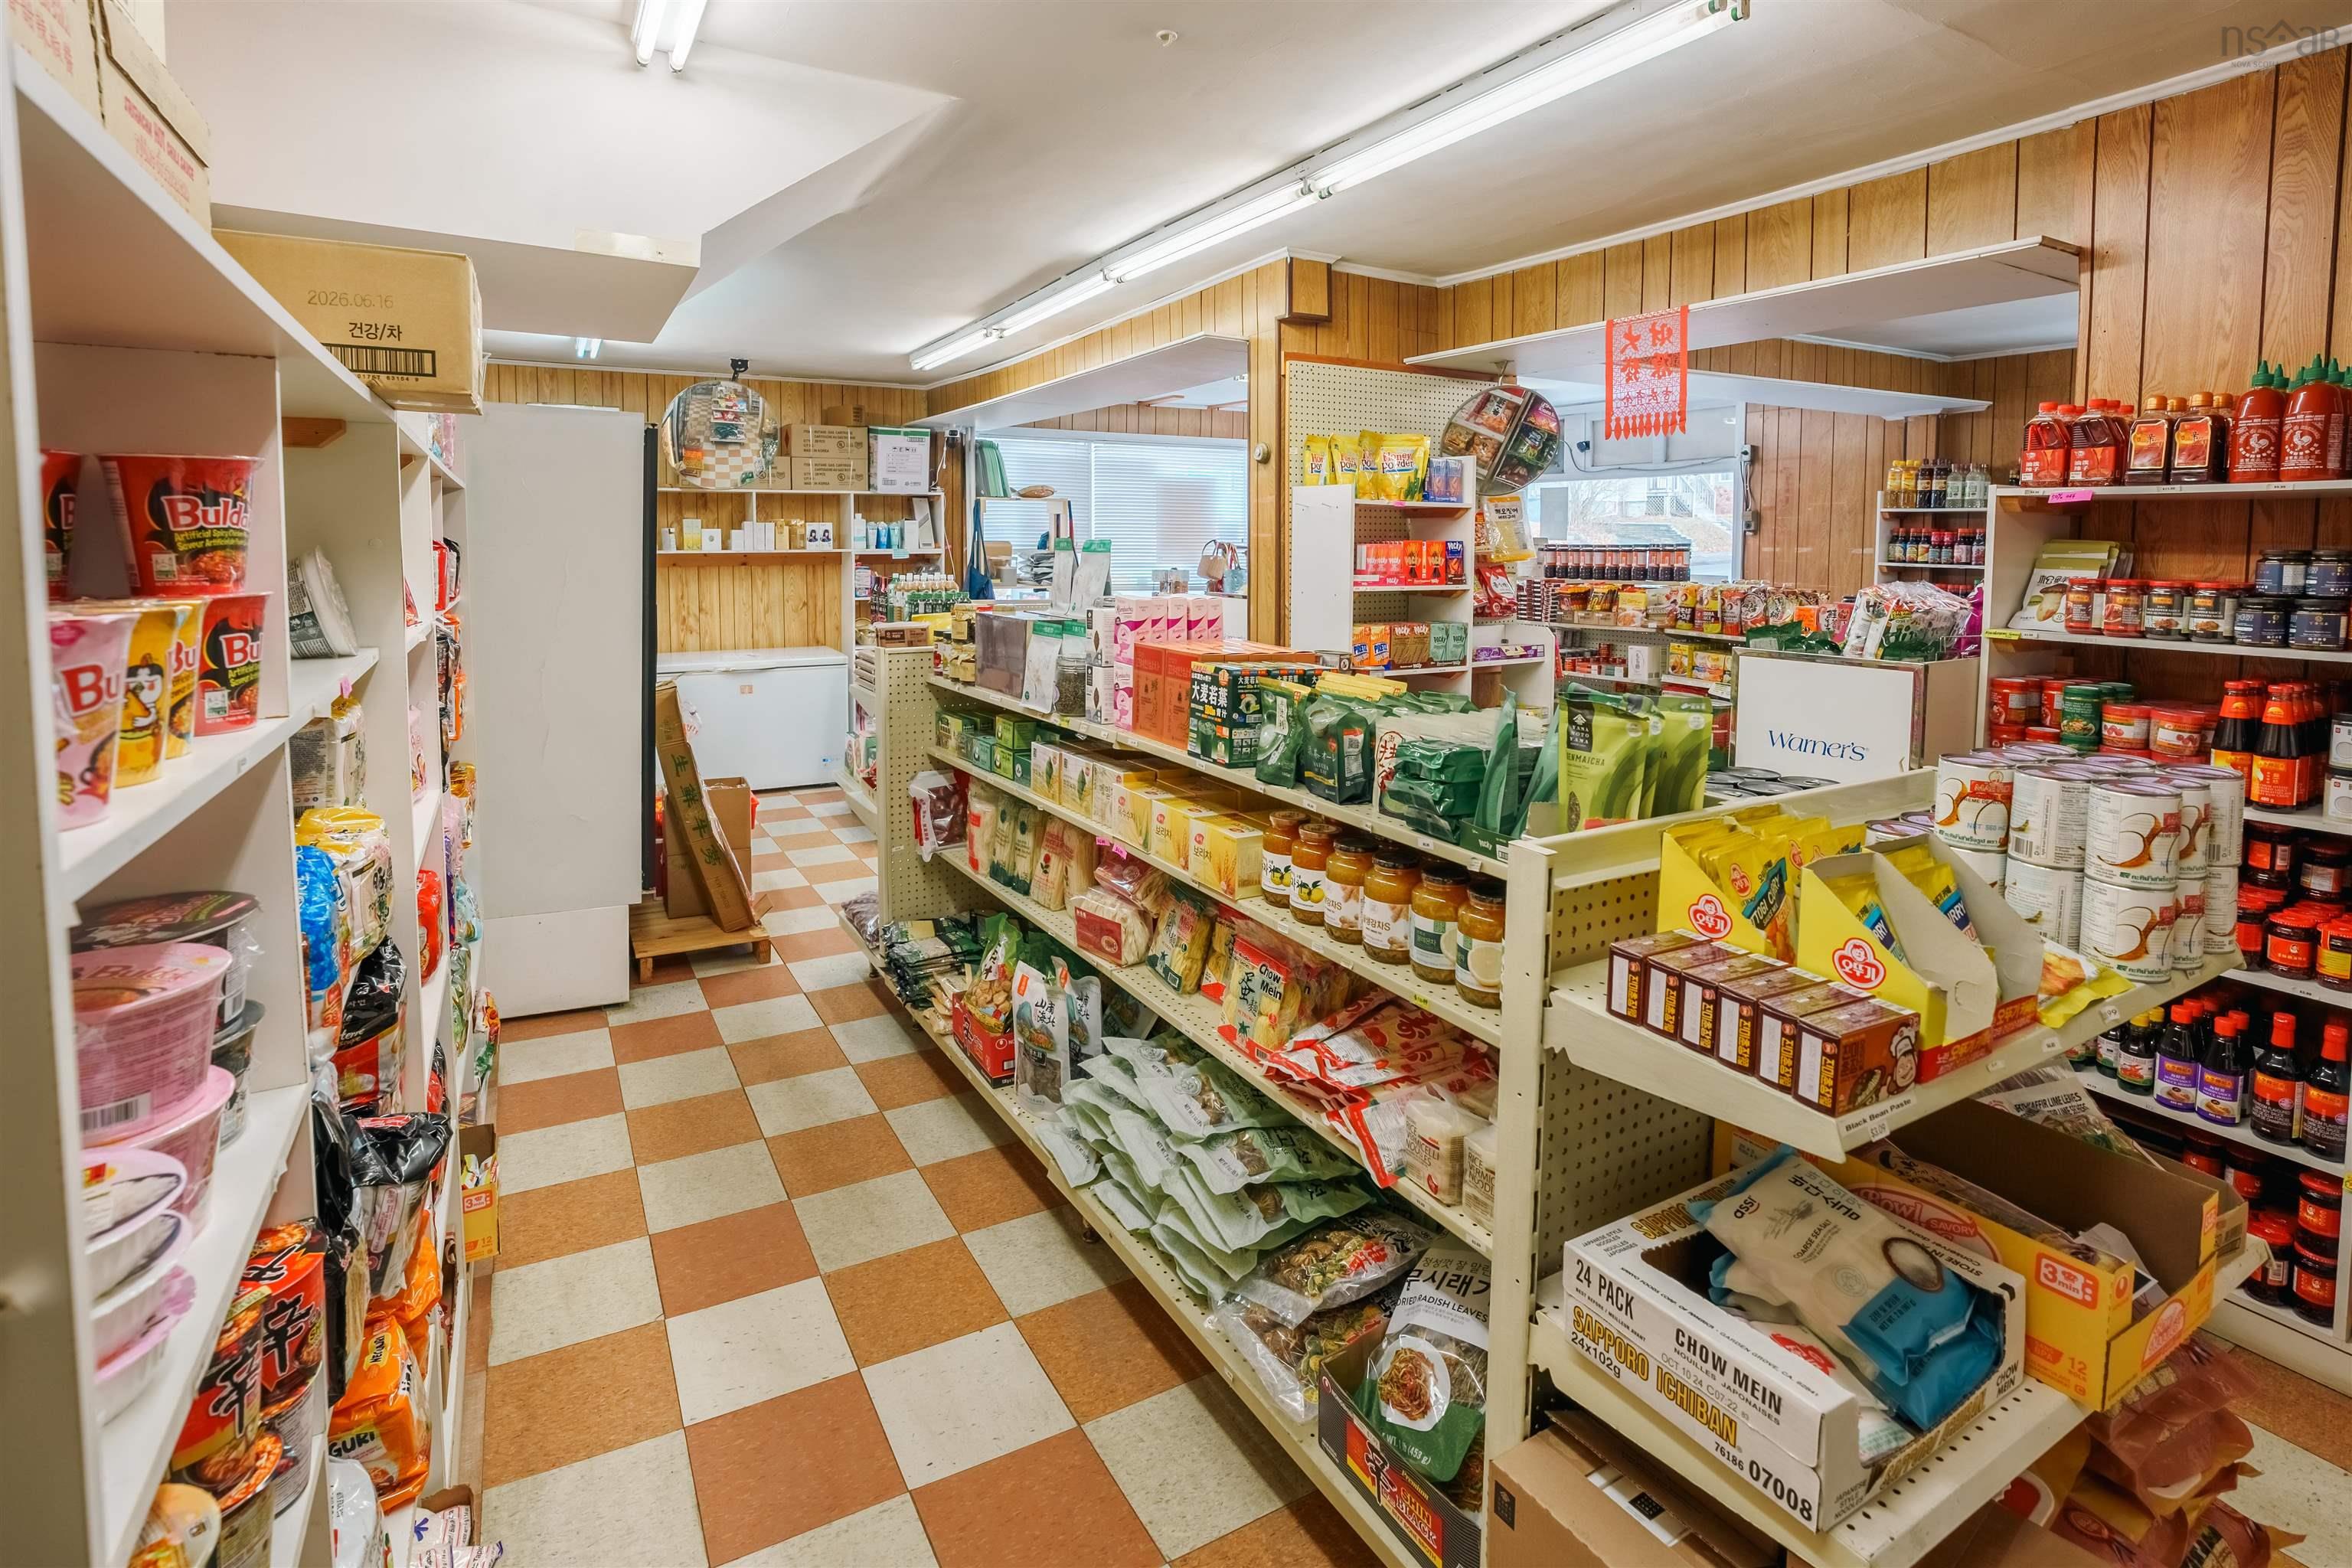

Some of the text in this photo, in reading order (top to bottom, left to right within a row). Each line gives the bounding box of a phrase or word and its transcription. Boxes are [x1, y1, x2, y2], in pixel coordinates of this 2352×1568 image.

[308, 290, 394, 309] 2026.06.16
[348, 322, 403, 341] 건강/차
[1381, 461, 1415, 474] Powder
[1447, 541, 1462, 551] POCKY
[1394, 626, 1410, 635] POCKY
[1413, 625, 1429, 635] POCKY
[1374, 642, 1388, 654] PRETZ
[1191, 681, 1228, 708] 大麦若葉
[1769, 730, 1866, 762] Warner's
[1155, 825, 1172, 841] 보리차
[1194, 845, 1212, 861] 보리차
[1768, 874, 1781, 904] CURRY
[1696, 913, 1724, 932] 오뚜기
[1259, 964, 1282, 985] Chow
[1841, 959, 1876, 981] 오뚜기
[1260, 979, 1282, 1001] Mein
[2047, 1095, 2062, 1107] LIME
[1845, 1097, 1913, 1133] Black Bean Paste
[1406, 1120, 1417, 1135] RICE
[1870, 1123, 1886, 1138] $3.09
[1406, 1131, 1440, 1161] VERMICELLI
[1468, 1152, 1484, 1170] RICE
[464, 1198, 473, 1210] 3
[1733, 1194, 1759, 1219] assi
[1788, 1173, 1861, 1221] 바다소금
[1583, 1227, 1623, 1248] JAPANESE STYLE
[1929, 1218, 1976, 1236] SAVORY
[481, 1235, 492, 1245] 12
[1596, 1235, 1621, 1247] NOODLES
[1604, 1240, 1629, 1253] NOUILLES
[1608, 1243, 1638, 1258] JAPONAISES
[1793, 1236, 1814, 1259] COARSE
[1907, 1228, 1981, 1266] Conserver dans
[1422, 1256, 1454, 1269] 정성껏
[1456, 1260, 1468, 1272] 잘
[1931, 1249, 1983, 1277] STORE IN
[1576, 1259, 1635, 1320] 24 PACK
[2043, 1263, 2079, 1295] 3 min
[1396, 1294, 1488, 1323] DRIED RADISH LEAVES
[1576, 1288, 1586, 1296] BEST
[1587, 1294, 1604, 1311] BEFORE
[1608, 1311, 1630, 1331] MEILLEUR
[1631, 1328, 1646, 1342] AVANT
[1621, 1266, 1640, 1281] SANYO
[1640, 1279, 1661, 1294] FOODS
[1687, 1312, 1715, 1329] AMERICA
[1720, 1331, 1751, 1353] GARDEN
[1752, 1352, 1779, 1371] GROVE,
[1571, 1331, 1622, 1378] 24x102g
[1573, 1305, 1738, 1449] SAPPORO ICHIBAN
[1661, 1353, 1679, 1371] OCT
[1682, 1367, 1691, 1380] 10
[1692, 1376, 1704, 1388] 24
[1675, 1327, 1728, 1377] CHOW
[1733, 1367, 1783, 1416] MEIN
[1996, 1361, 2019, 1387] CHOW
[2068, 1357, 2088, 1376] 12
[1674, 1348, 1781, 1426] NOUILLES JAPONAISES
[1997, 1376, 2017, 1398] MEIN
[328, 1430, 375, 1458] GURI
[1406, 1446, 1423, 1462] (453
[1421, 1454, 1432, 1465] g)
[1402, 1469, 1429, 1501] Premium
[1714, 1441, 1813, 1523] 76186 07008
[1835, 1478, 1867, 1504] JAPANESE
[1400, 1485, 1432, 1529] SHIN
[1839, 1493, 1859, 1509] STYLE
[1396, 1494, 1437, 1549] BLACK
